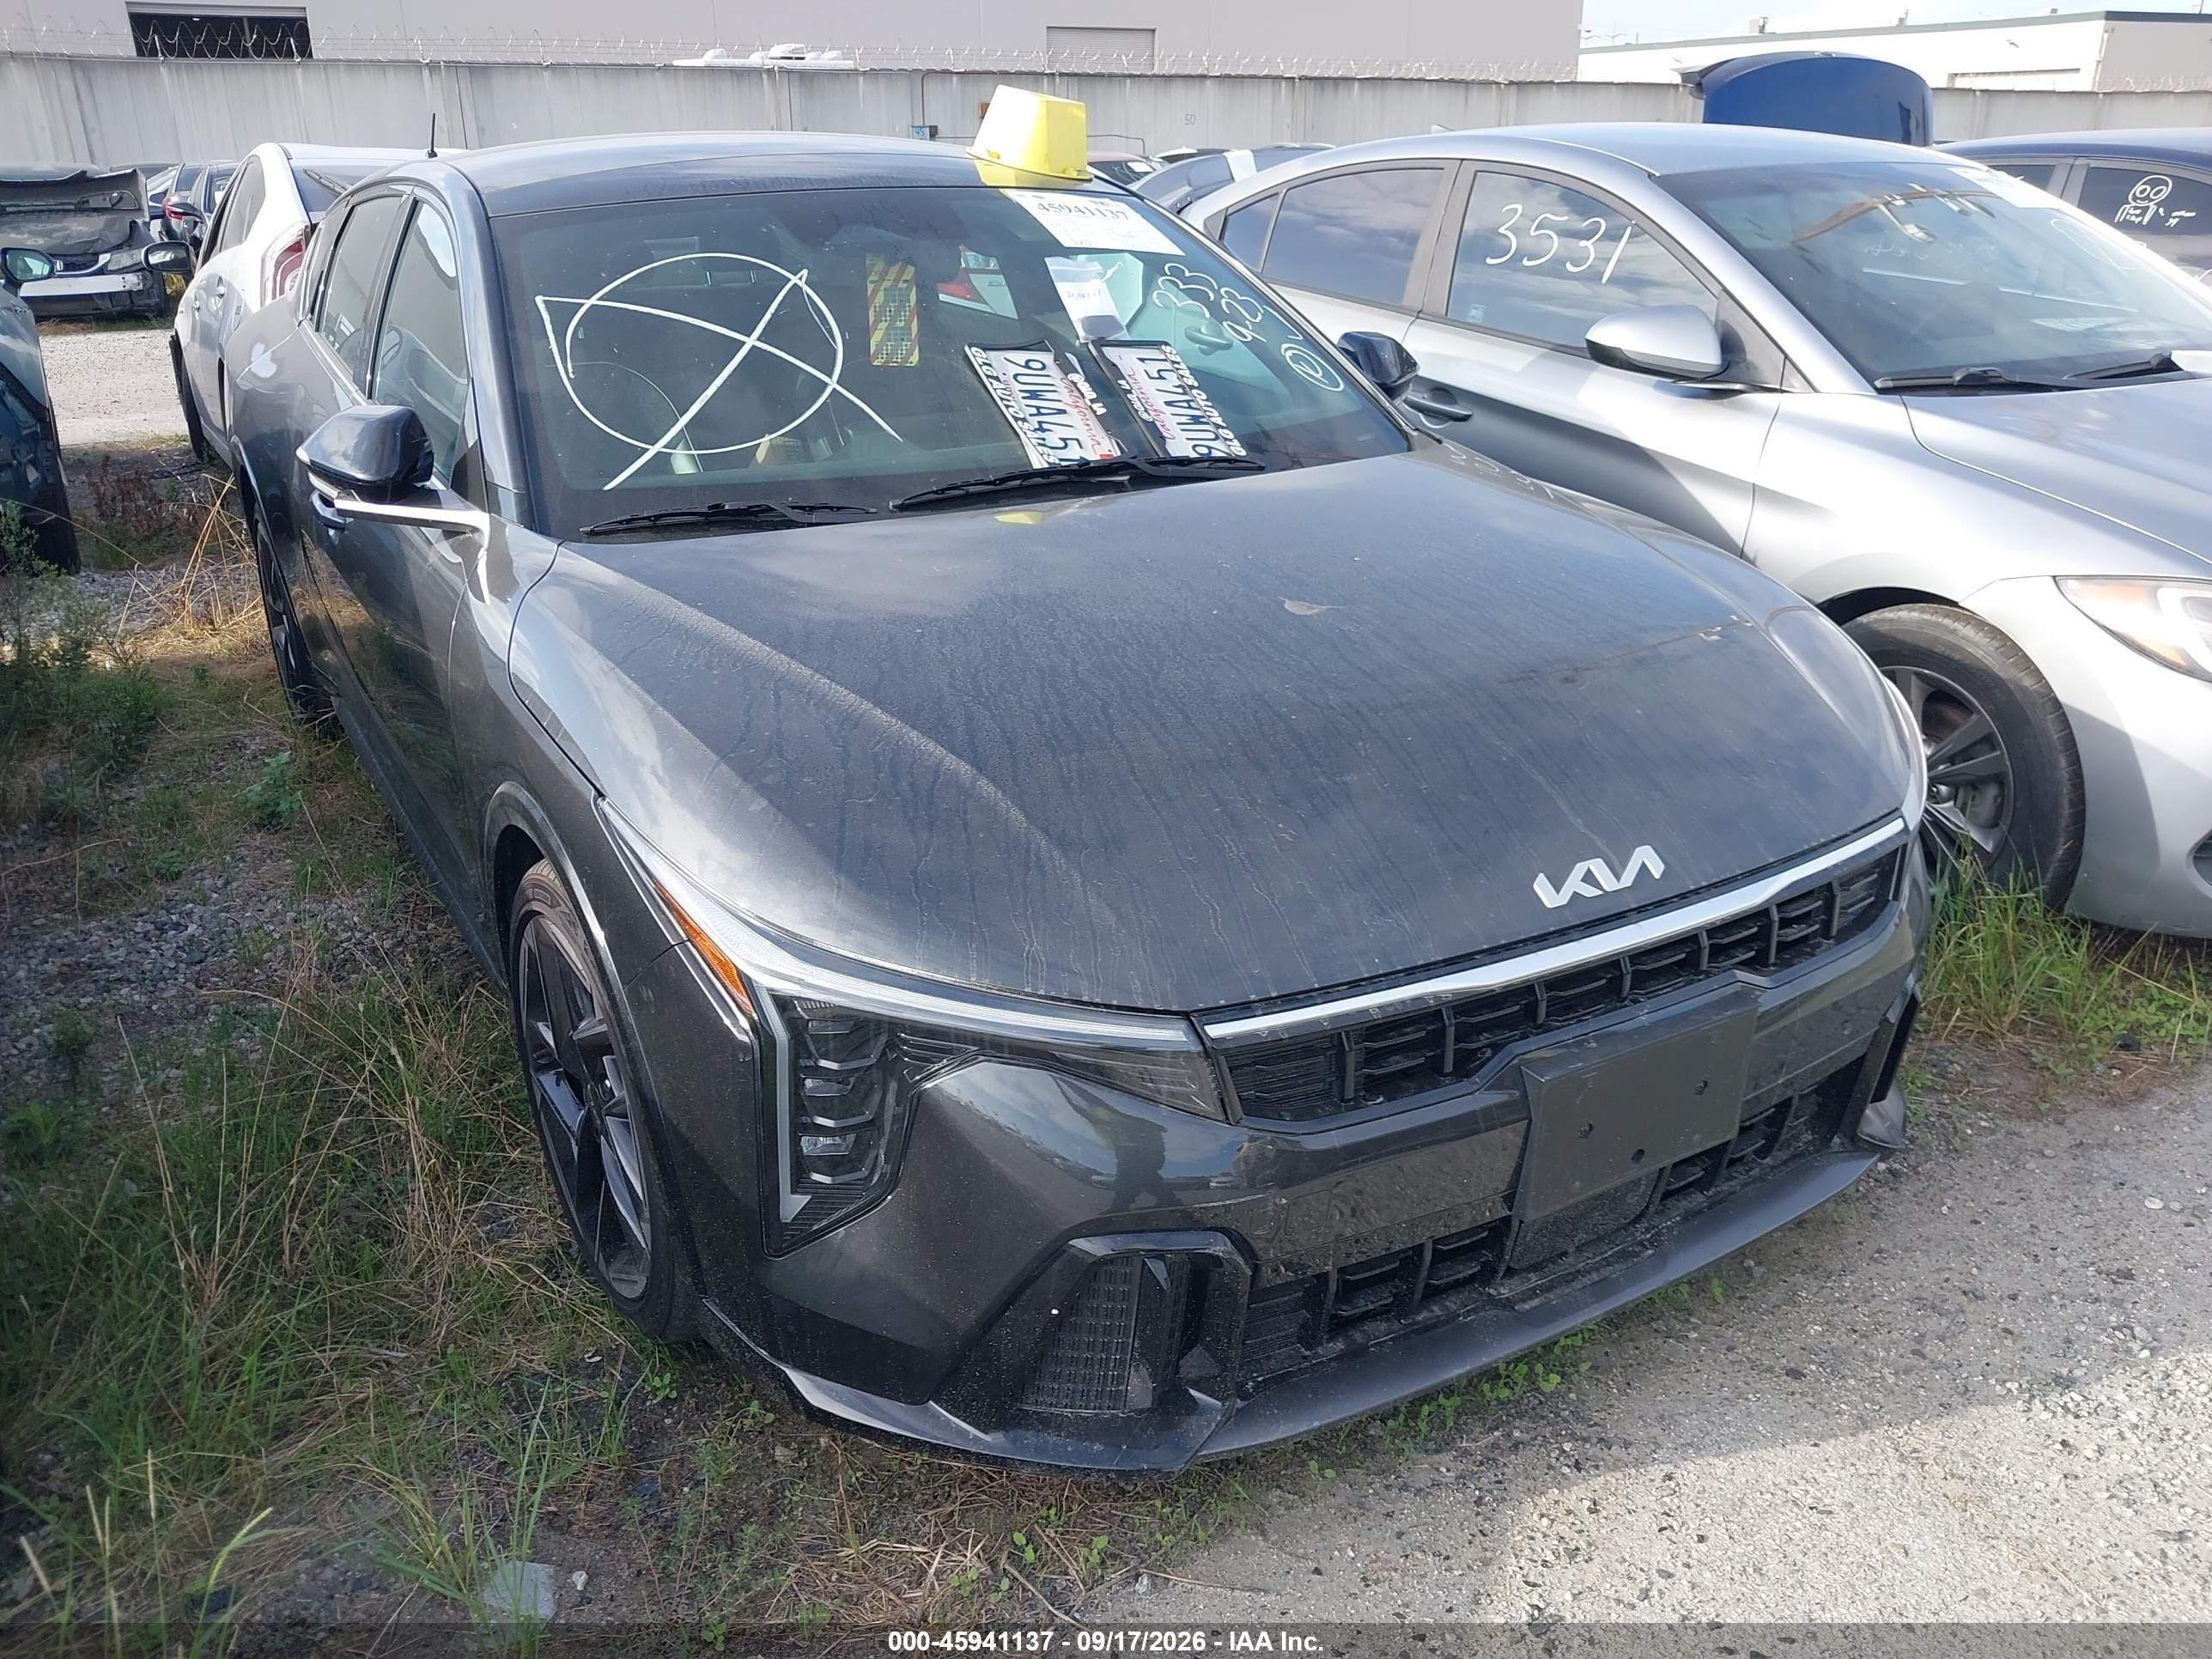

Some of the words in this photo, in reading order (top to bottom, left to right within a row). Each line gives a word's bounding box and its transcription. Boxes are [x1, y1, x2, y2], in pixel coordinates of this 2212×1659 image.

[1485, 204, 1632, 284] 3531
[1152, 263, 1218, 319] 333
[1160, 343, 1200, 388] SALES
[969, 346, 999, 377] GLG
[988, 375, 1025, 420] AUTO
[1017, 419, 1060, 465] SALES
[1003, 356, 1091, 468] 9UWA451
[1059, 376, 1103, 454] California
[1127, 366, 1176, 441] California
[1136, 356, 1233, 458] 9UWA451
[1190, 388, 1228, 428] AUTO
[1217, 428, 1248, 457] GLG
[1533, 845, 1666, 909] KIA
